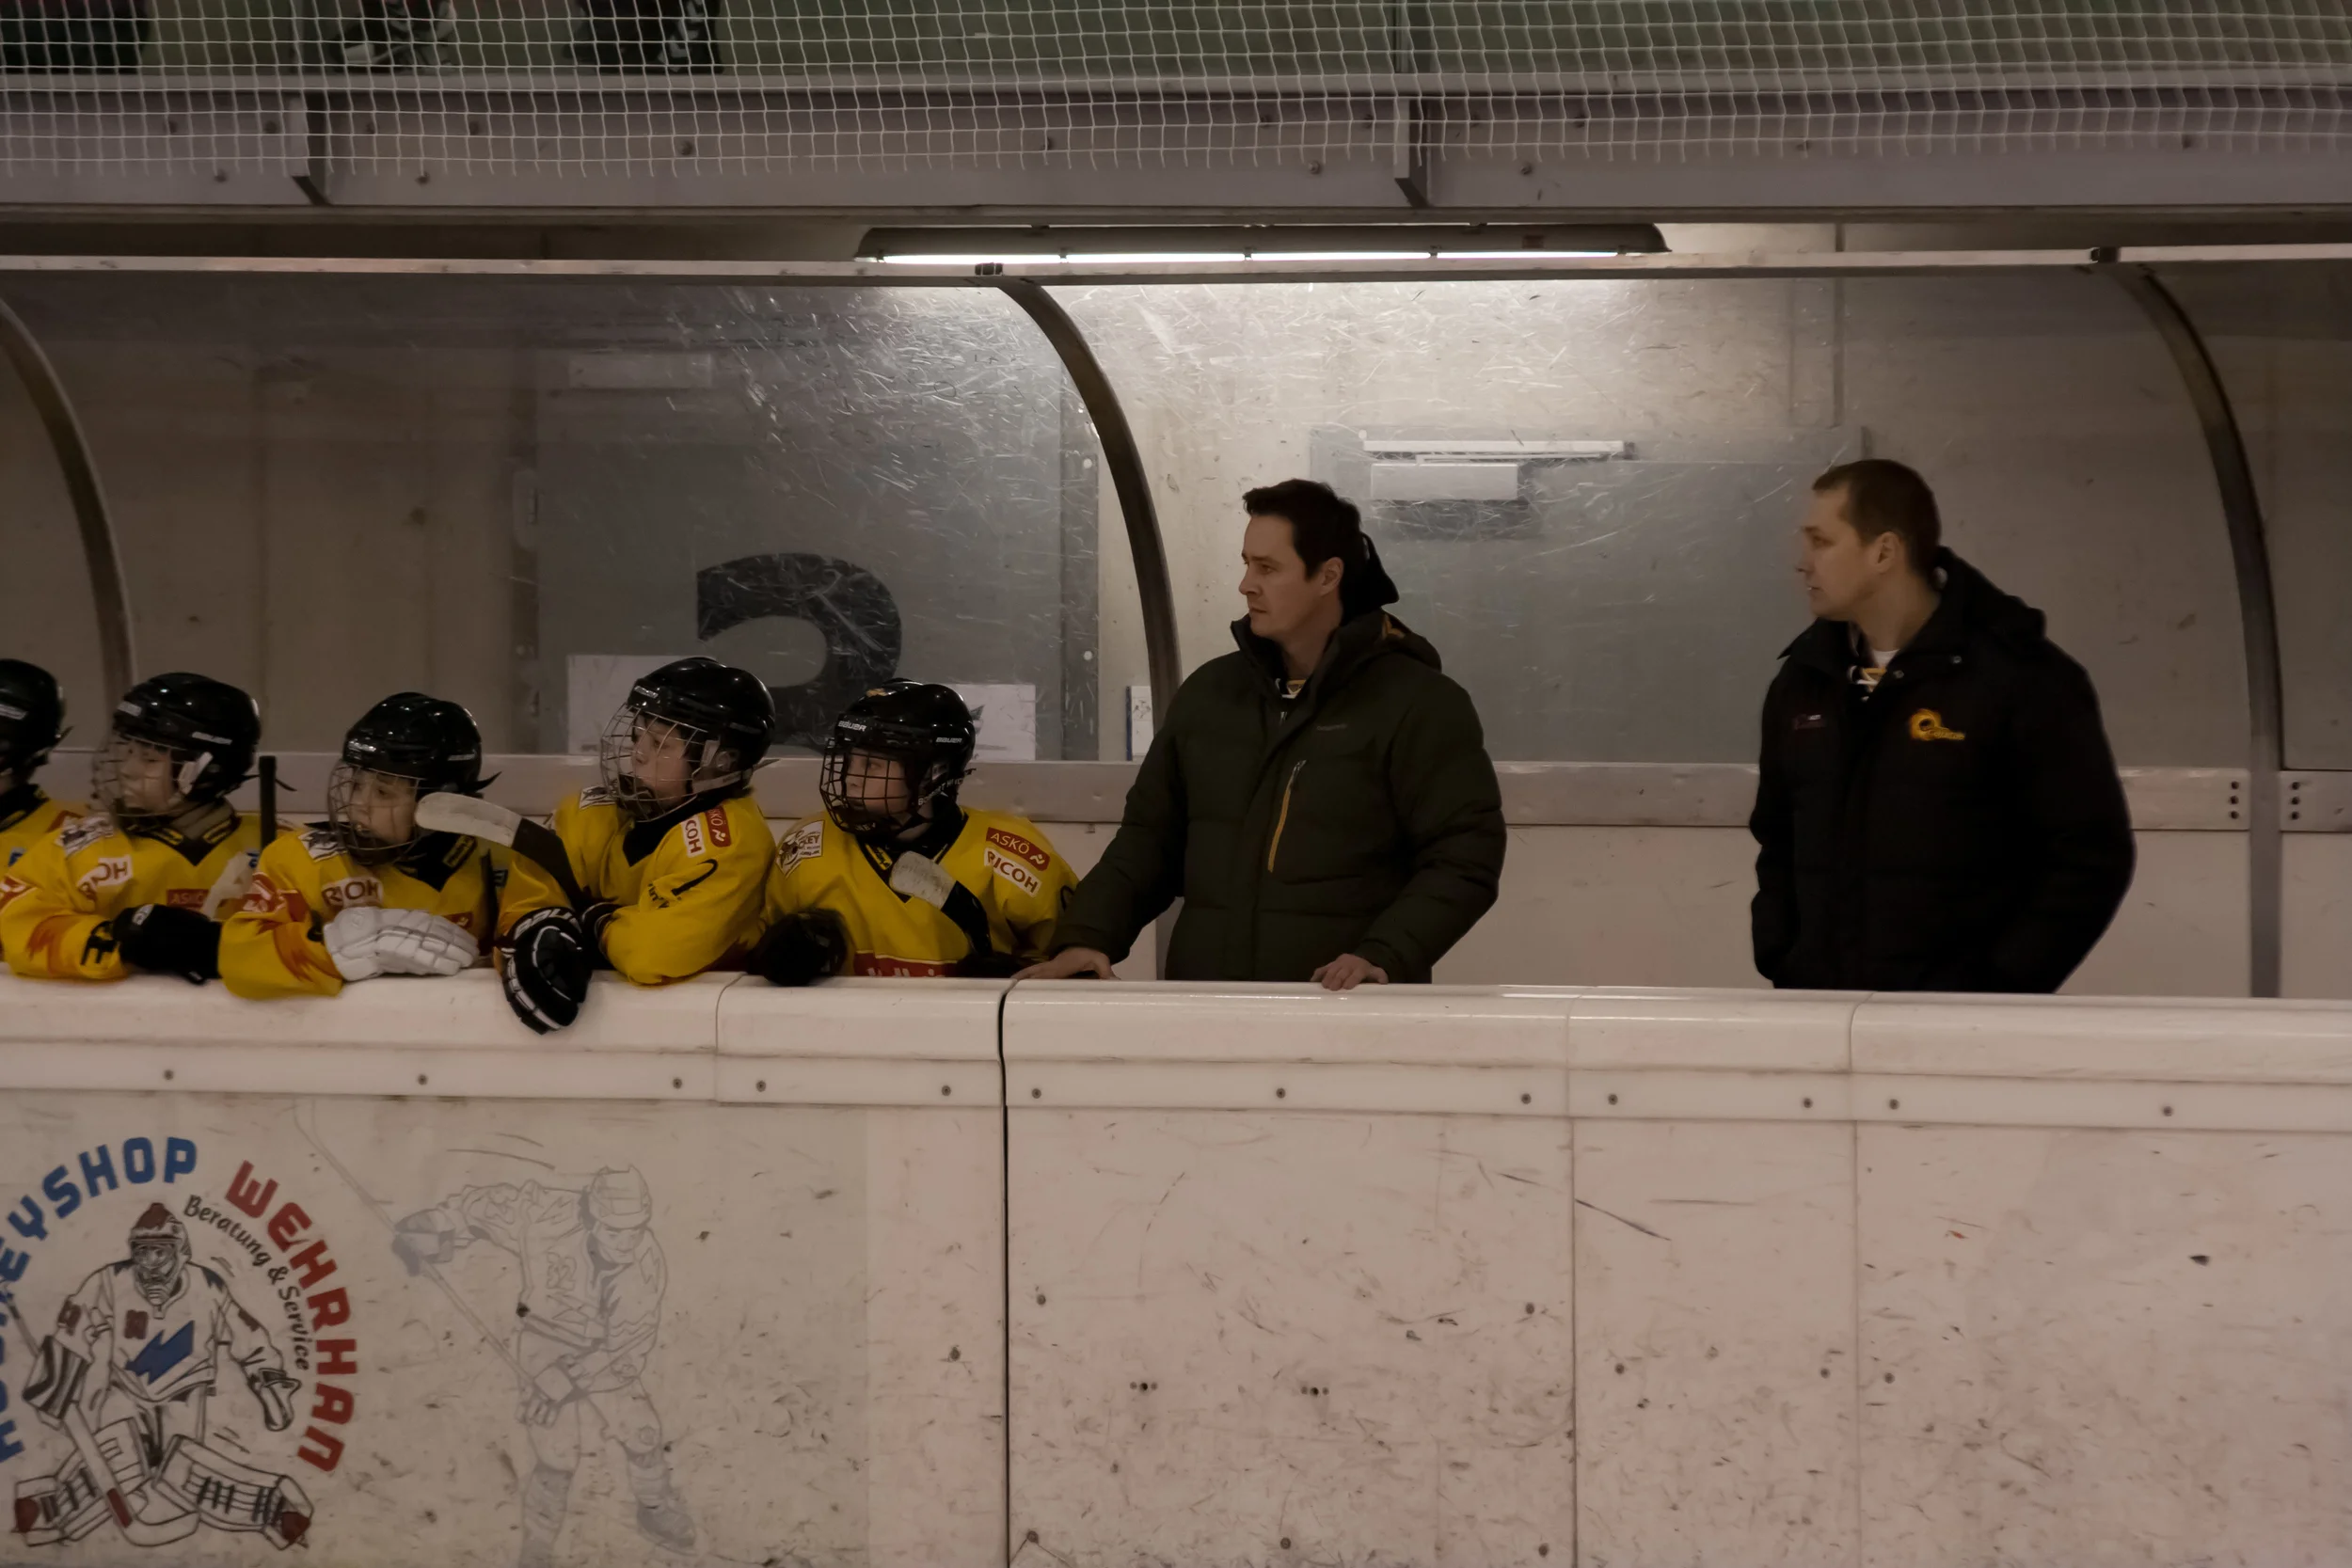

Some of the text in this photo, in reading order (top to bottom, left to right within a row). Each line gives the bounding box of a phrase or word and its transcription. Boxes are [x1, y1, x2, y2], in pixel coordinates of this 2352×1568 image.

[837, 720, 867, 732] BAUER
[990, 832, 1031, 855] ASKÖ
[183, 1194, 314, 1371] Beratung & Service
[225, 1159, 358, 1472] WEHRHAN
